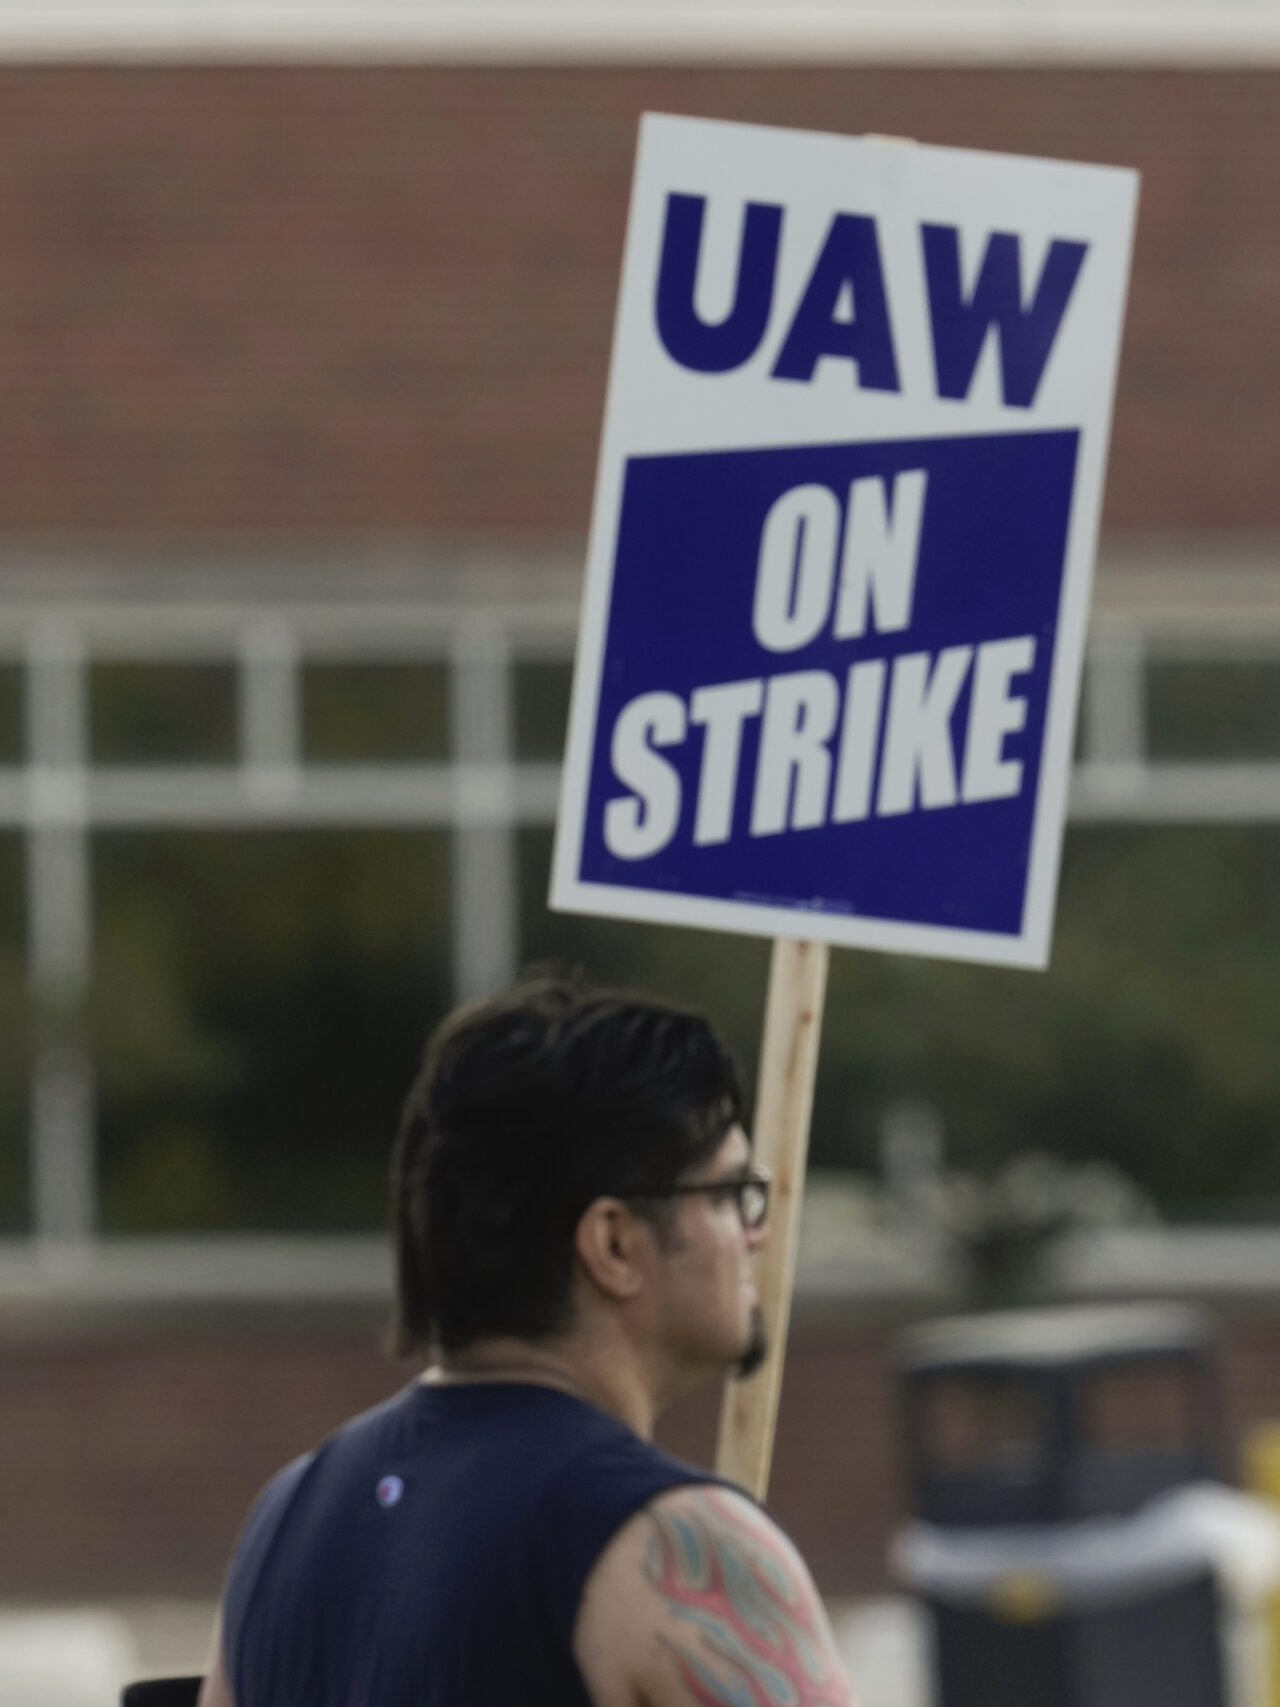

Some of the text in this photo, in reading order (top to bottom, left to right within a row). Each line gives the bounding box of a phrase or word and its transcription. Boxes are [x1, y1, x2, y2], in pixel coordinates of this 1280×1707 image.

[654, 191, 1090, 410] UAW
[752, 468, 928, 653] ON
[603, 635, 1036, 862] STRIKE
